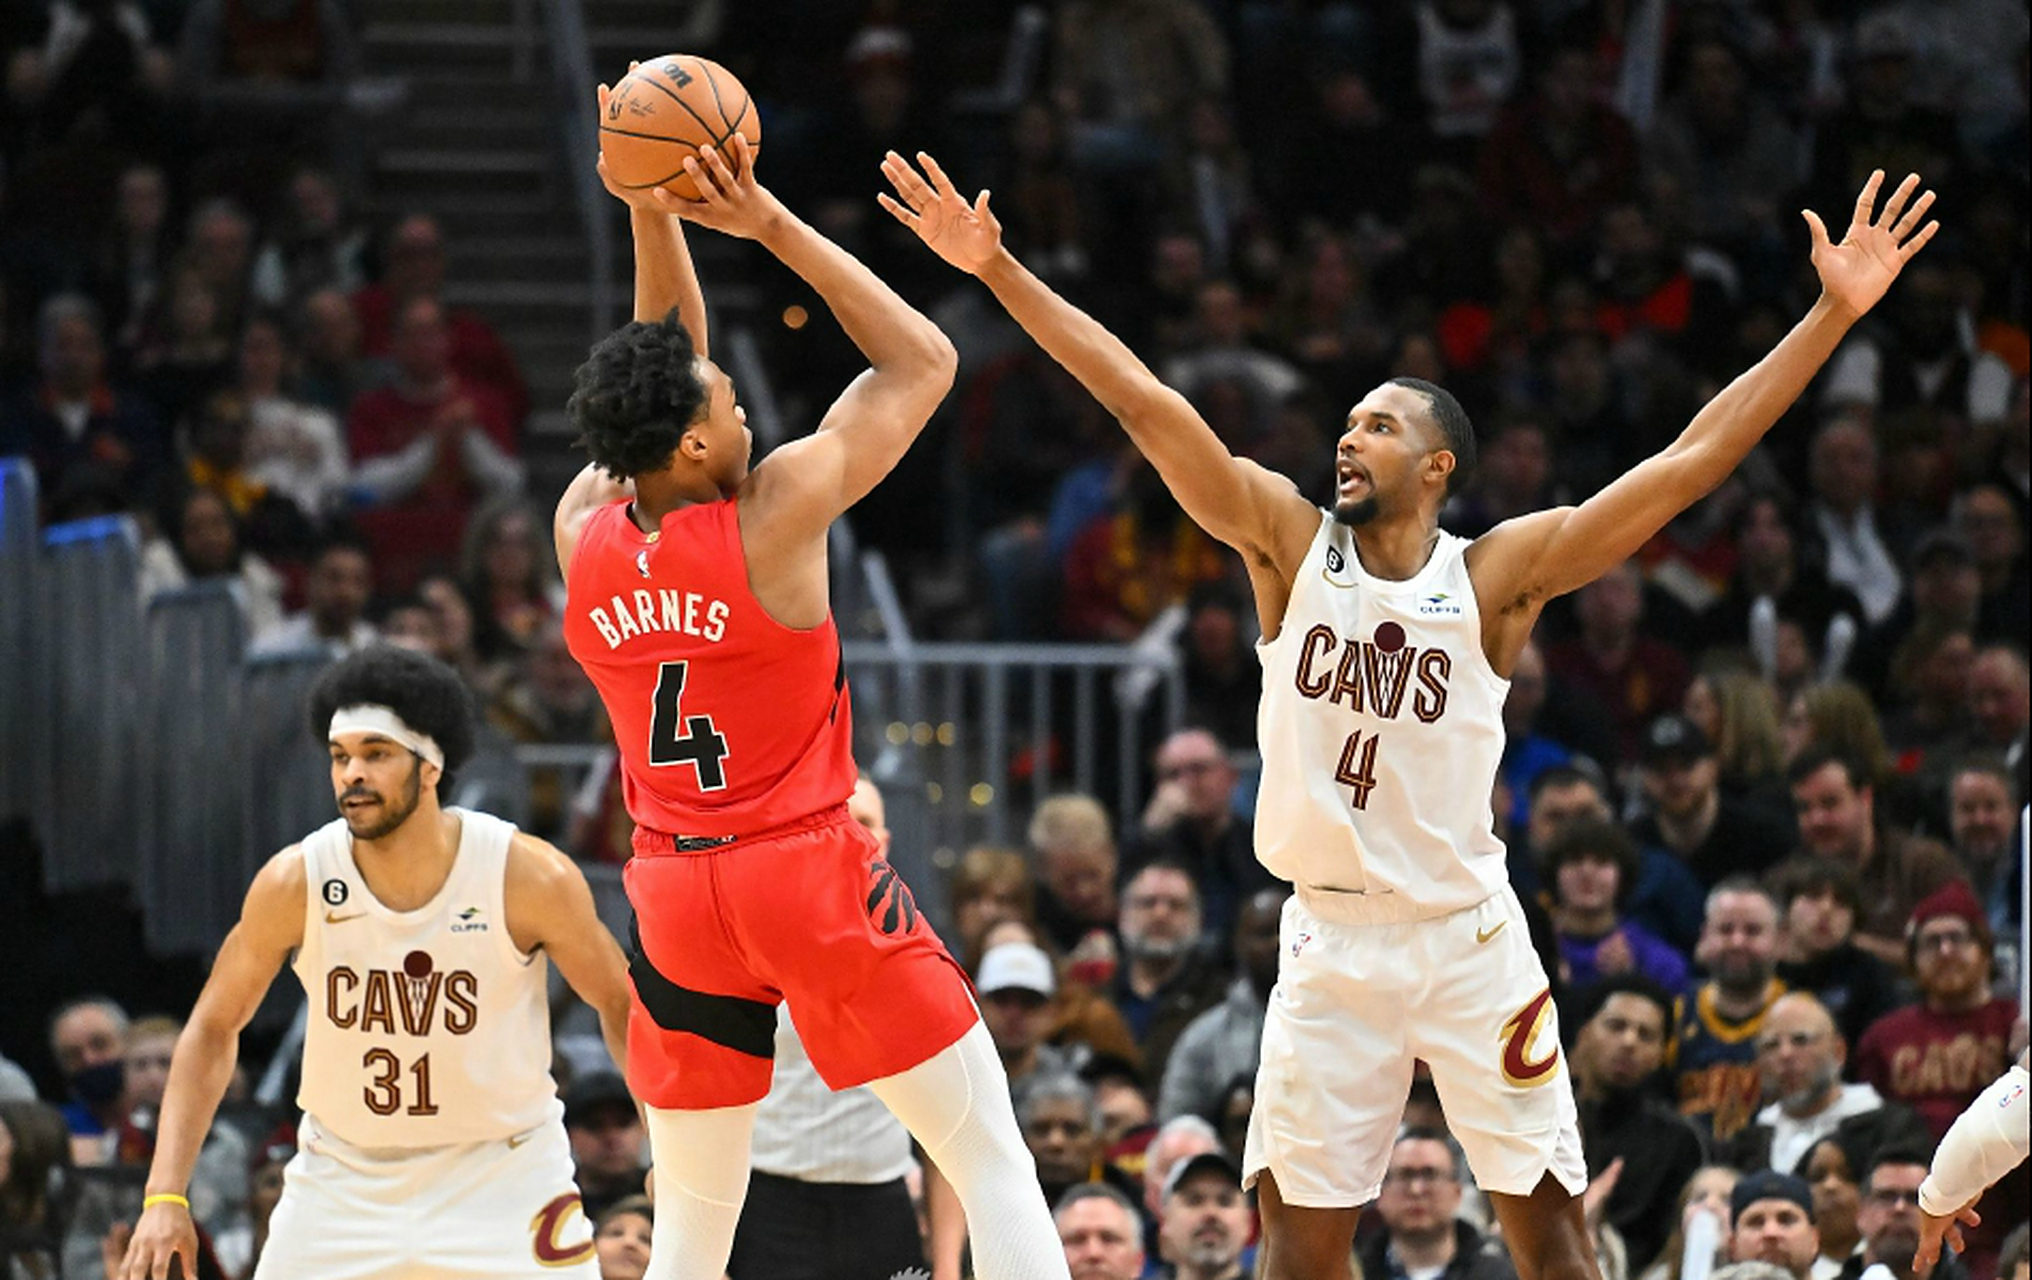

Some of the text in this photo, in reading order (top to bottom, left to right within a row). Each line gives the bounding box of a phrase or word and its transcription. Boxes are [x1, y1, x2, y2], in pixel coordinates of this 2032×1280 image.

[589, 589, 731, 649] BARNES
[1295, 622, 1452, 724] CAVS
[649, 660, 731, 792] 4
[1334, 729, 1380, 811] 4
[327, 881, 344, 903] 6
[450, 923, 488, 933] CLIFFS
[327, 963, 478, 1036] CAVS
[363, 1047, 439, 1116] 31
